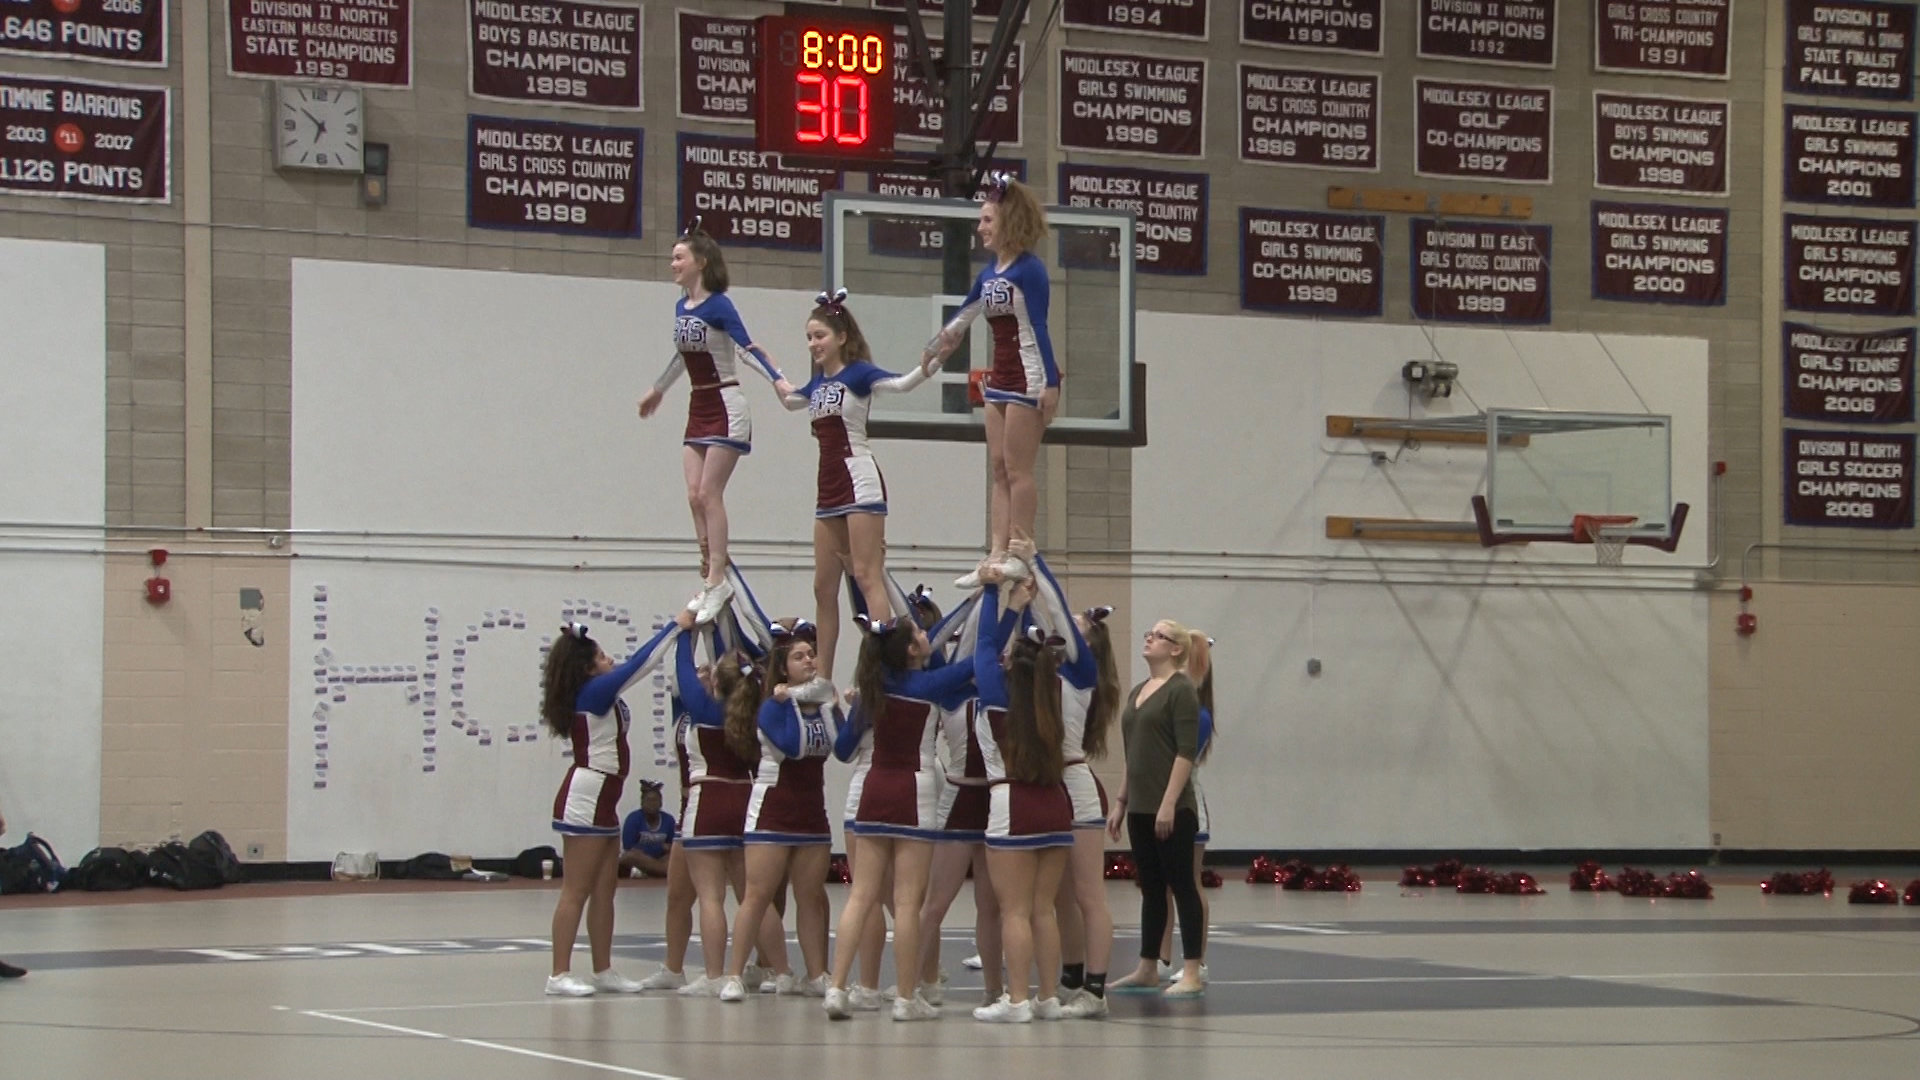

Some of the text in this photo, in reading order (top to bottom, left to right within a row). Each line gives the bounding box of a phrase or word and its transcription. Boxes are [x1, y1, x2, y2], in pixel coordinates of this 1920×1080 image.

[102, 0, 141, 13] 2006
[251, 2, 312, 18] DIVISION
[320, 5, 332, 18] II
[340, 8, 389, 25] NORTH
[476, 1, 635, 31] MIDDLESEX LEAGUE
[1108, 5, 1162, 26] 1994
[1251, 3, 1373, 29] CHAMPIONS
[1431, 1, 1544, 20] DIVISION II NORTH
[1608, 3, 1718, 26] GIRLS CROSS COUNTRY
[1428, 15, 1545, 40] CHAMPIONS
[1814, 7, 1889, 28] DIVISION II
[61, 21, 142, 50] POINTS
[241, 17, 398, 44] EASTERN MASSACHUSETTS
[479, 24, 631, 54] BOYS BASKETBALL
[707, 23, 748, 36] BELMONT
[1613, 25, 1714, 47] TRI-CHAMPIONS
[1798, 25, 1821, 42] GIRLS
[246, 35, 395, 64] STATE CHAMPIONS
[691, 37, 744, 55] GIRLS
[803, 31, 883, 74] 8:00
[1640, 47, 1686, 65] 1991
[486, 49, 626, 78] CHAMPIONS
[698, 55, 750, 72] DIVISION
[1804, 47, 1897, 68] STATE FINALIST
[1065, 56, 1199, 82] MIDDLESEX LEAGUE
[1800, 67, 1900, 88] FALL 2013
[526, 75, 588, 97] 1995
[1078, 80, 1187, 104] GIRLS SWIMMING
[1247, 73, 1372, 98] MIDDLESEX LEAGUE
[62, 90, 142, 120] BARROWS
[702, 95, 748, 112] 1995
[796, 73, 868, 144] 30
[1246, 94, 1370, 119] GIRLS CROSS COUNTRY
[1424, 87, 1545, 112] MIDDLESEX LEAGUE
[1073, 101, 1192, 126] CHAMPIONS
[1459, 112, 1510, 130] GOLF
[1601, 103, 1723, 126] MIDDLESEX LEAGUE
[284, 119, 296, 131] 9
[346, 123, 358, 136] 3
[1106, 125, 1158, 144] 1996
[1252, 116, 1367, 140] CHAMPIONS
[1614, 124, 1709, 146] BOYS SWIMMING
[1792, 115, 1910, 137] MIDDLESEX LEAGUE
[6, 125, 46, 142] 2003
[95, 133, 133, 150] 2007
[477, 128, 634, 158] MIDDLESEX LEAGUE
[1426, 129, 1542, 152] CO-CHAMPIONS
[1805, 137, 1898, 157] GIRLS SWIMMING
[316, 153, 328, 165] 6
[685, 145, 768, 168] MIDDLESEX
[1248, 137, 1371, 161] 1996 1997
[1609, 144, 1715, 166] CHAMPIONS
[479, 152, 631, 180] GIRLS CROSS COUNTRY
[1458, 153, 1508, 171] 1997
[1799, 157, 1901, 178] CHAMPIONS
[64, 162, 143, 189] POINTS
[703, 170, 819, 195] GIRLS SWIMMING
[485, 177, 625, 204] CHAMPIONS
[1069, 175, 1198, 200] MIDDLESEX LEAGUE
[1827, 180, 1872, 197] 2001
[525, 203, 586, 224] 1998
[696, 193, 823, 218] CHAMPIONS
[1149, 203, 1198, 222] COUNTRY
[731, 217, 790, 238] 1998
[1249, 219, 1375, 242] MIDDLESEX LEAGUE
[1598, 212, 1722, 234] MIDDLESEX LEAGUE
[1426, 231, 1535, 251] DIVISION III EAST
[1610, 233, 1709, 254] GIRLS SWIMMING
[1791, 225, 1910, 246] MIDDLESEX LEAGUE
[1261, 241, 1363, 262] GIRLS SWIMMING
[1420, 251, 1541, 272] GIRLS CROSS COUNTRY
[1804, 245, 1896, 265] GIRLS SWIMMING
[1253, 262, 1373, 284] CO-CHAMPIONS
[1605, 253, 1715, 274] CHAMPIONS
[1425, 272, 1537, 292] CHAMPIONS
[1633, 275, 1685, 293] 2000
[1799, 265, 1901, 286] CHAMPIONS
[1824, 287, 1876, 304] 2002
[1791, 333, 1907, 353] MIDDLESEX LEAGUE
[1800, 353, 1900, 372] GIRLS TENNIS
[1798, 373, 1902, 392] CHAMPIONS
[1799, 440, 1901, 458] DIVISION II NORTH
[1797, 461, 1902, 478] GIRLS SOCCER
[1798, 481, 1901, 498] CHAMPIONS
